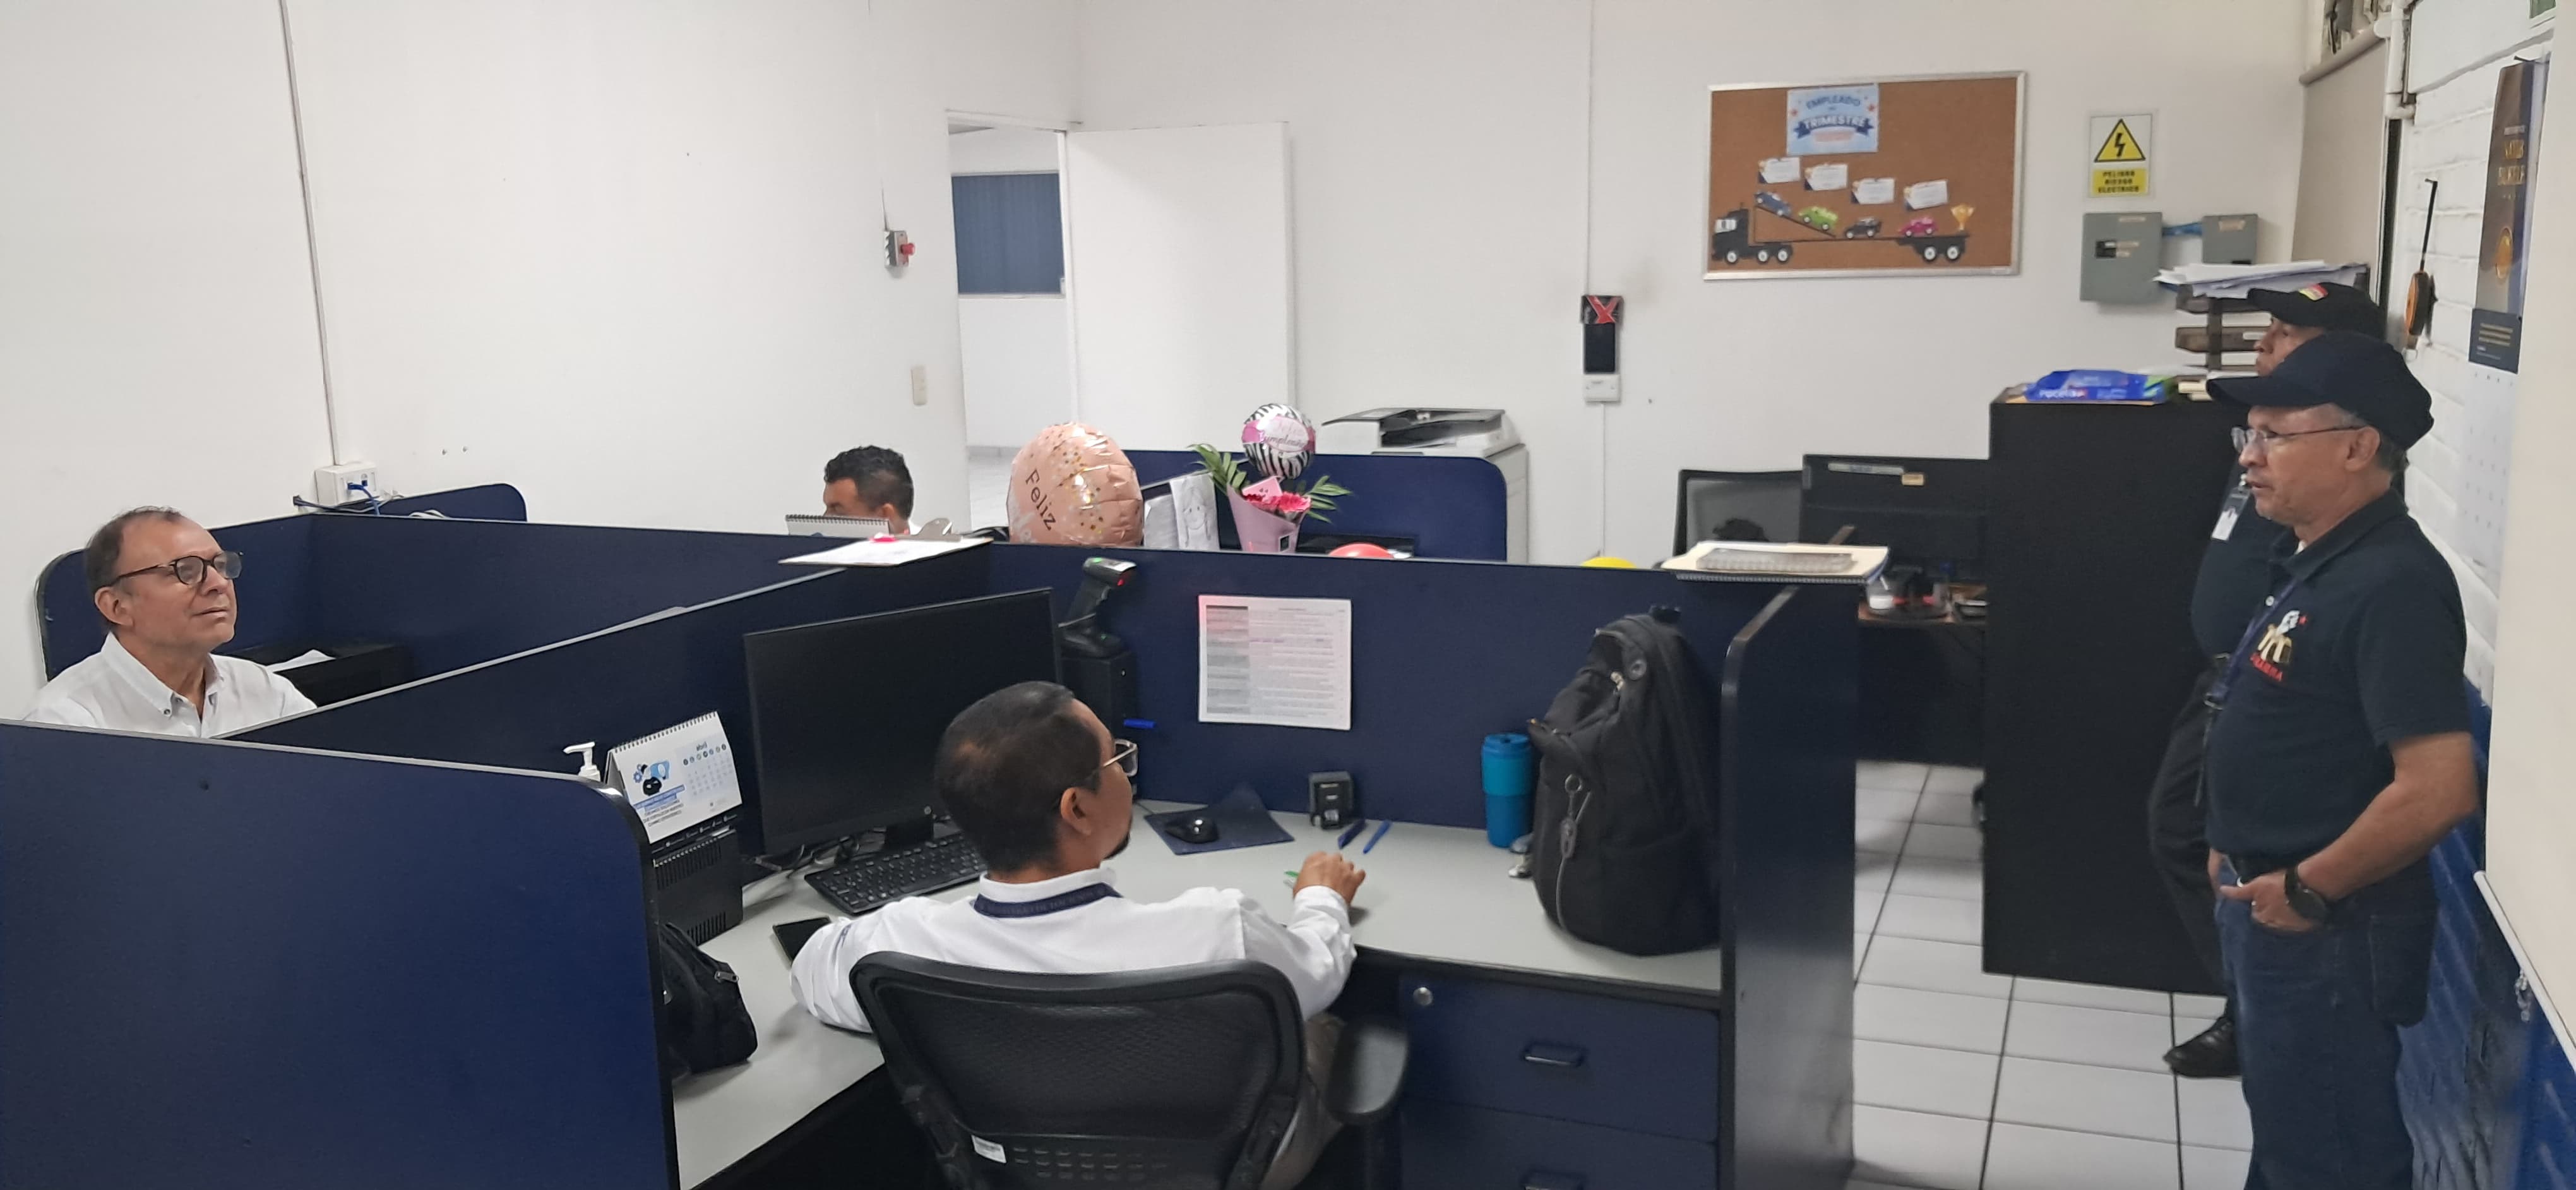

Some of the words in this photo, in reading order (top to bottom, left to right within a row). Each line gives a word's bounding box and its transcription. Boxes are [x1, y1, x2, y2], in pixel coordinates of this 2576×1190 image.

[1806, 95, 1861, 110] EMPLEADO
[1803, 115, 1865, 129] TRIMESTRE
[1025, 469, 1056, 531] Feliz
